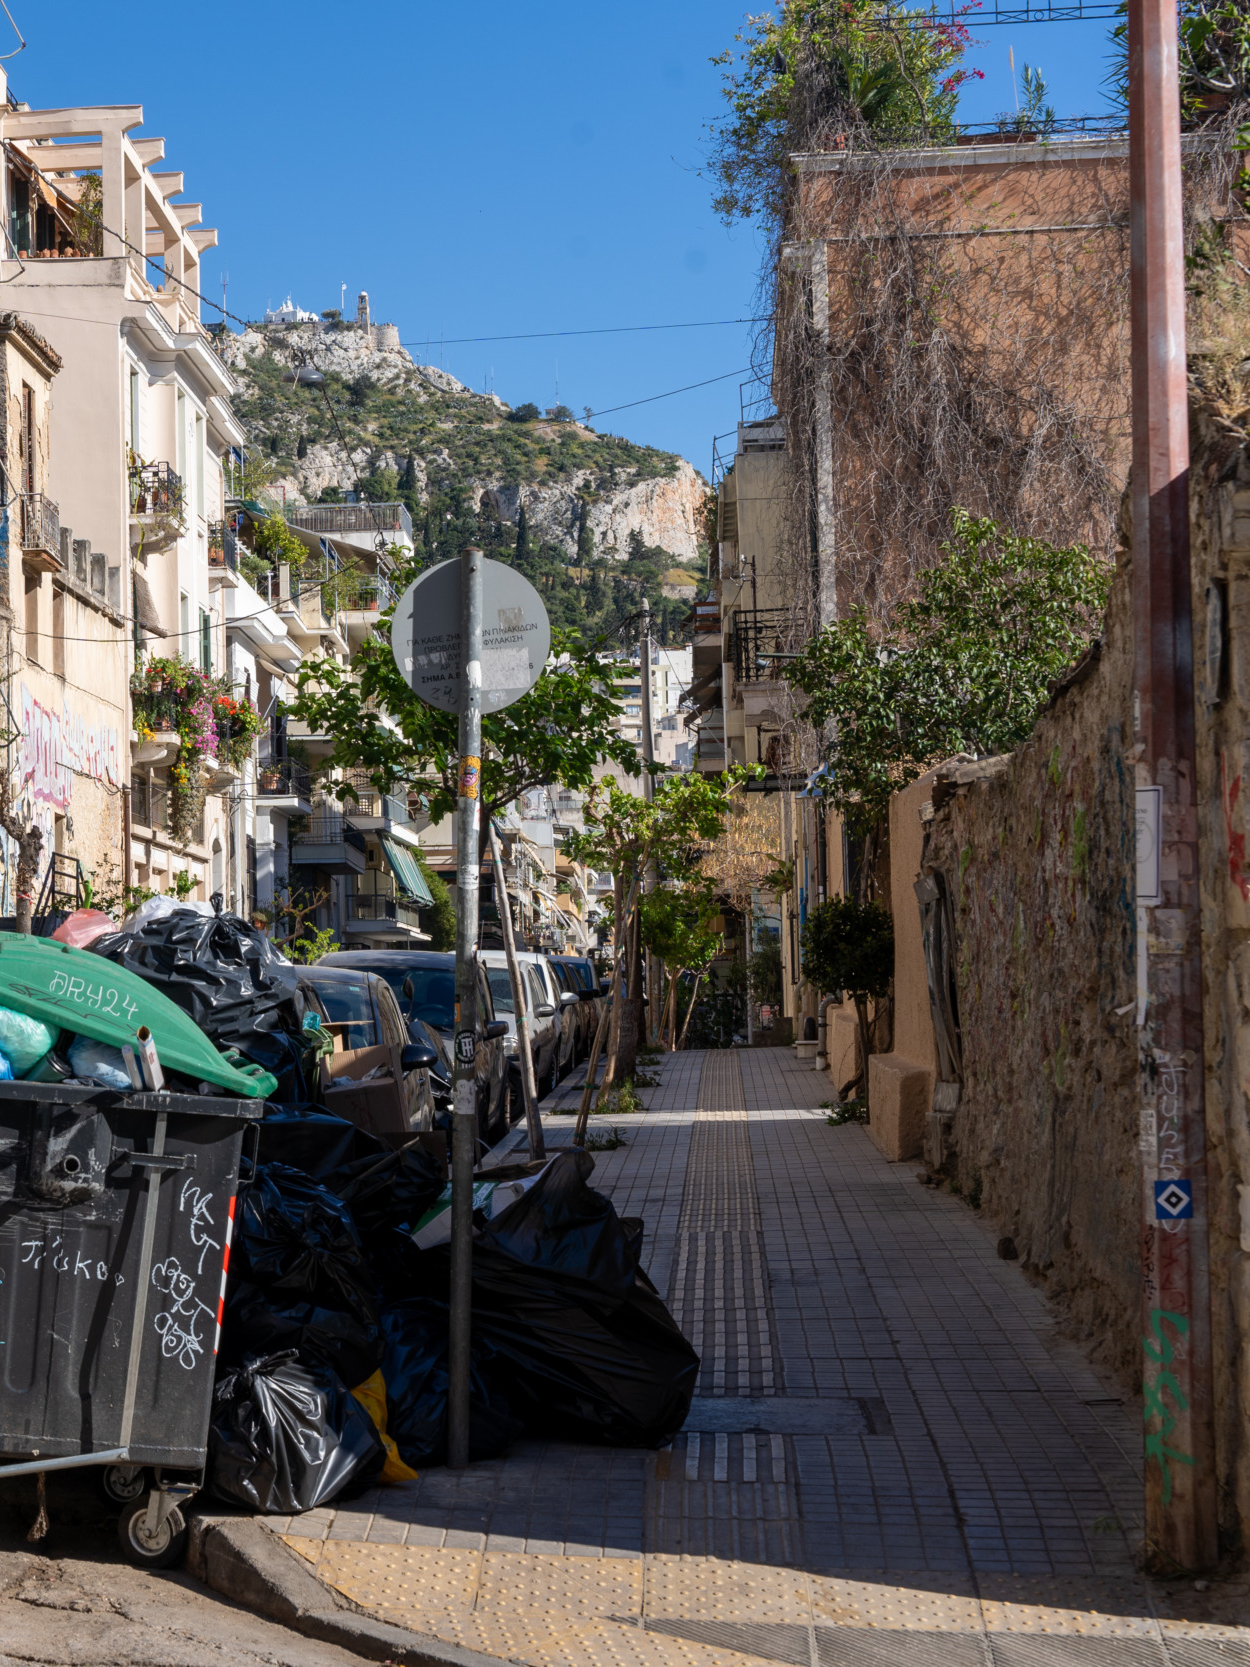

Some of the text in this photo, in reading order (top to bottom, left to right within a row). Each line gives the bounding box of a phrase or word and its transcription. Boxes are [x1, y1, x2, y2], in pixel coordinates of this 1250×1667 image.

[421, 635, 444, 644] ΚΑΘΕ
[483, 634, 523, 646] ΦΥΛΑΚΙΣΗ
[421, 674, 446, 684] ΣΗΜΑ
